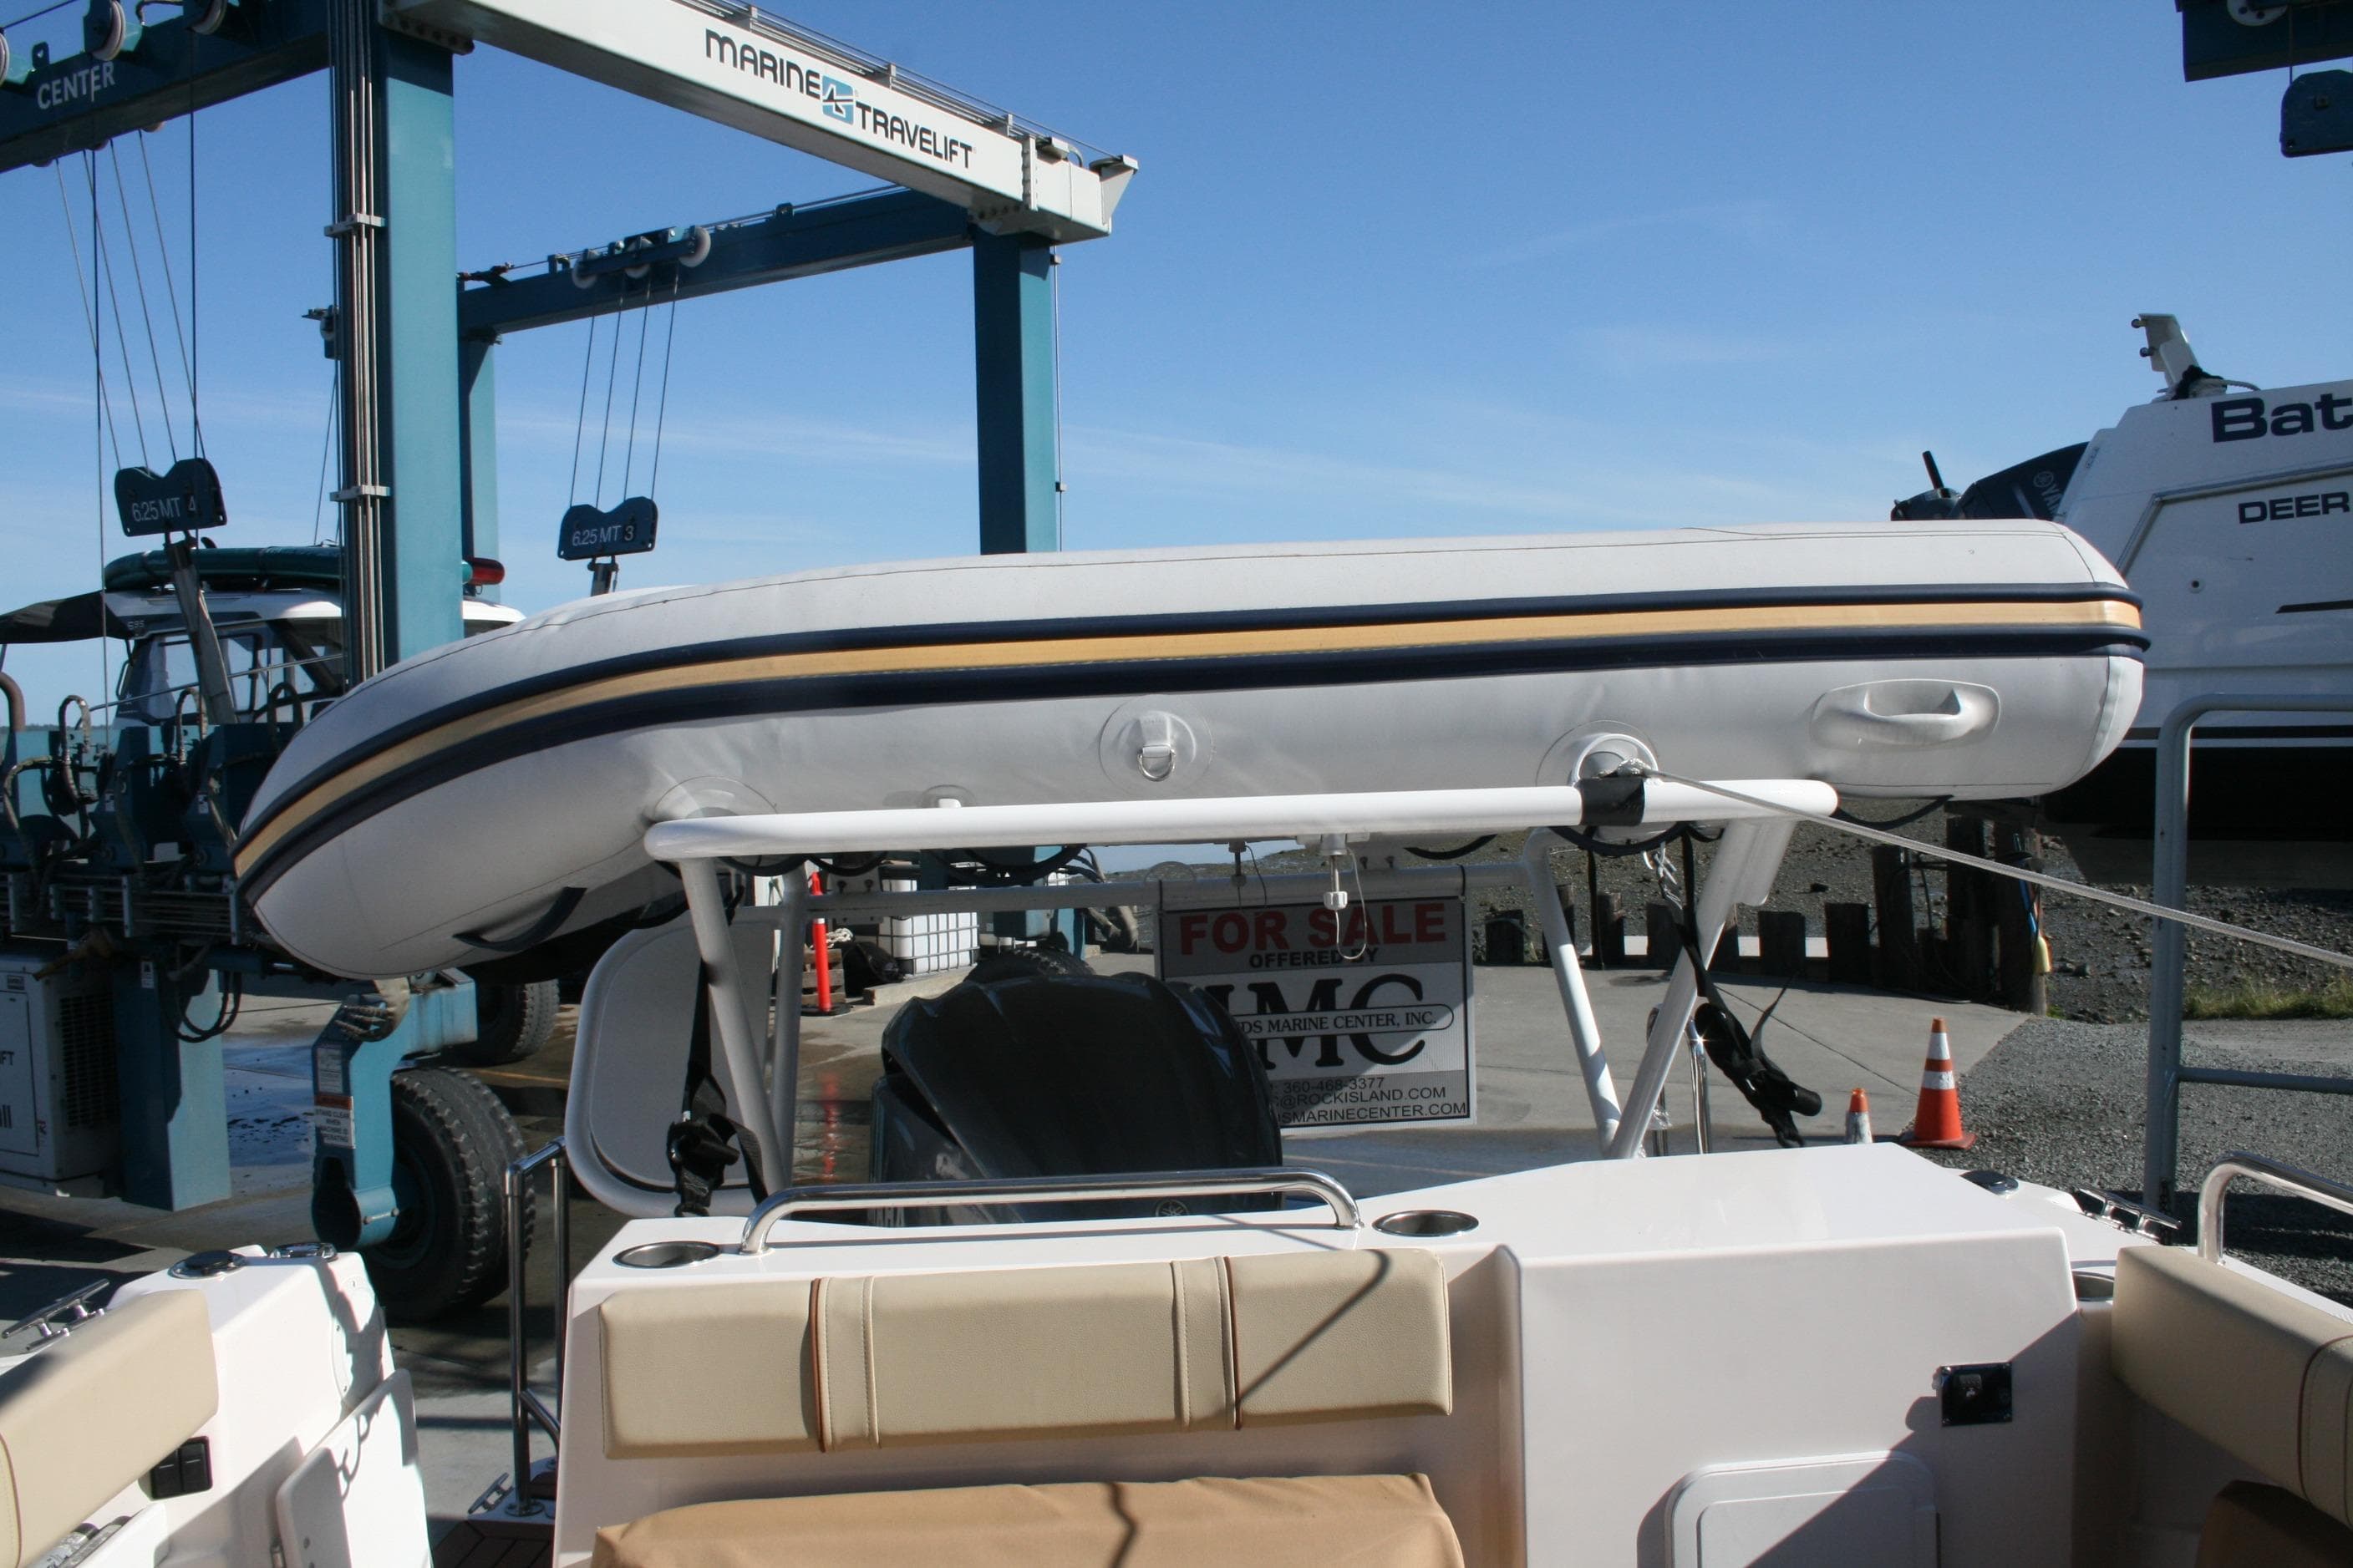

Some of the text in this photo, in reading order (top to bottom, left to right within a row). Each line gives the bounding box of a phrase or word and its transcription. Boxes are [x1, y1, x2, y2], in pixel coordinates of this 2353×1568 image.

[37, 61, 115, 109] CENTER
[705, 28, 973, 169] MARINE TRAVELIFT
[2210, 393, 2353, 444] Bat
[159, 497, 181, 518] MT
[188, 495, 197, 511] 4
[2238, 491, 2350, 525] DEER
[599, 525, 623, 543] MT
[623, 525, 635, 541] 3
[1179, 902, 1446, 957] FOR SALE
[1248, 946, 1379, 969] OFFERED BY
[1268, 1016, 1329, 1034] MARINE
[1333, 1012, 1400, 1031] CENTER,
[1405, 1011, 1437, 1026] INC.
[1283, 1077, 1385, 1094] 360-468-3377
